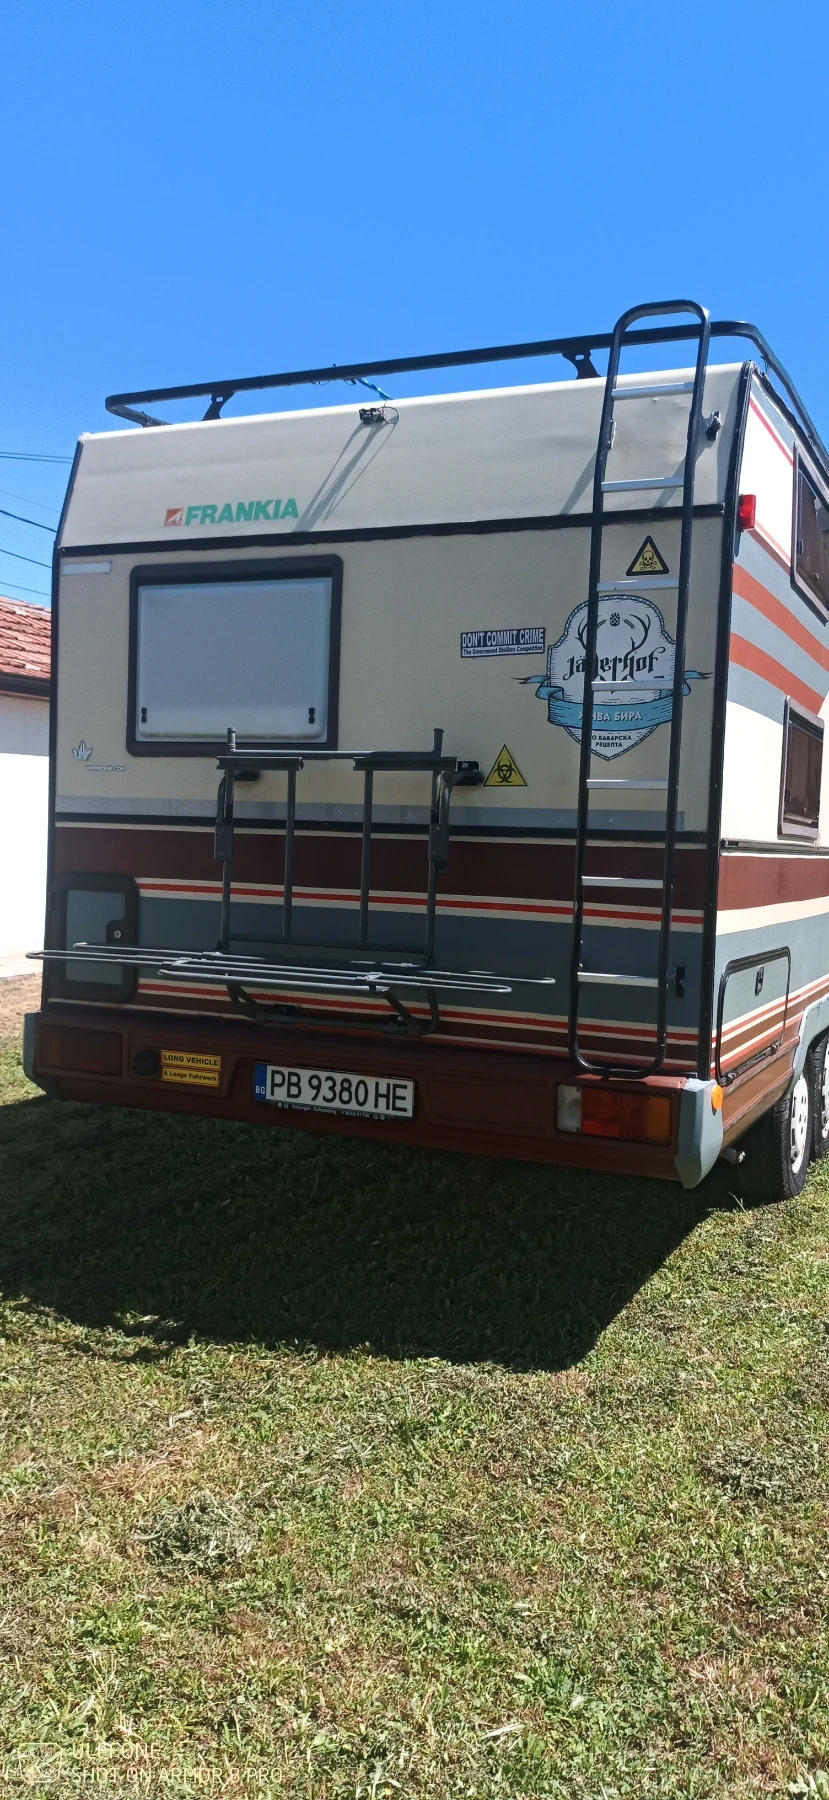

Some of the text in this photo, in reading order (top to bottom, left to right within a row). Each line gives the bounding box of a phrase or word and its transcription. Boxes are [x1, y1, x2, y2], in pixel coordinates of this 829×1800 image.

[184, 498, 299, 526] FRANKIA
[462, 628, 544, 648] DON'T COMMIT CRIME
[516, 645, 543, 653] Competition
[614, 711, 643, 721] БИРА
[163, 1054, 219, 1066] LONG VEHICLE
[188, 1073, 217, 1081] Fuhrwerk
[255, 1085, 266, 1094] BG
[270, 1069, 408, 1112] PB 9380 HE
